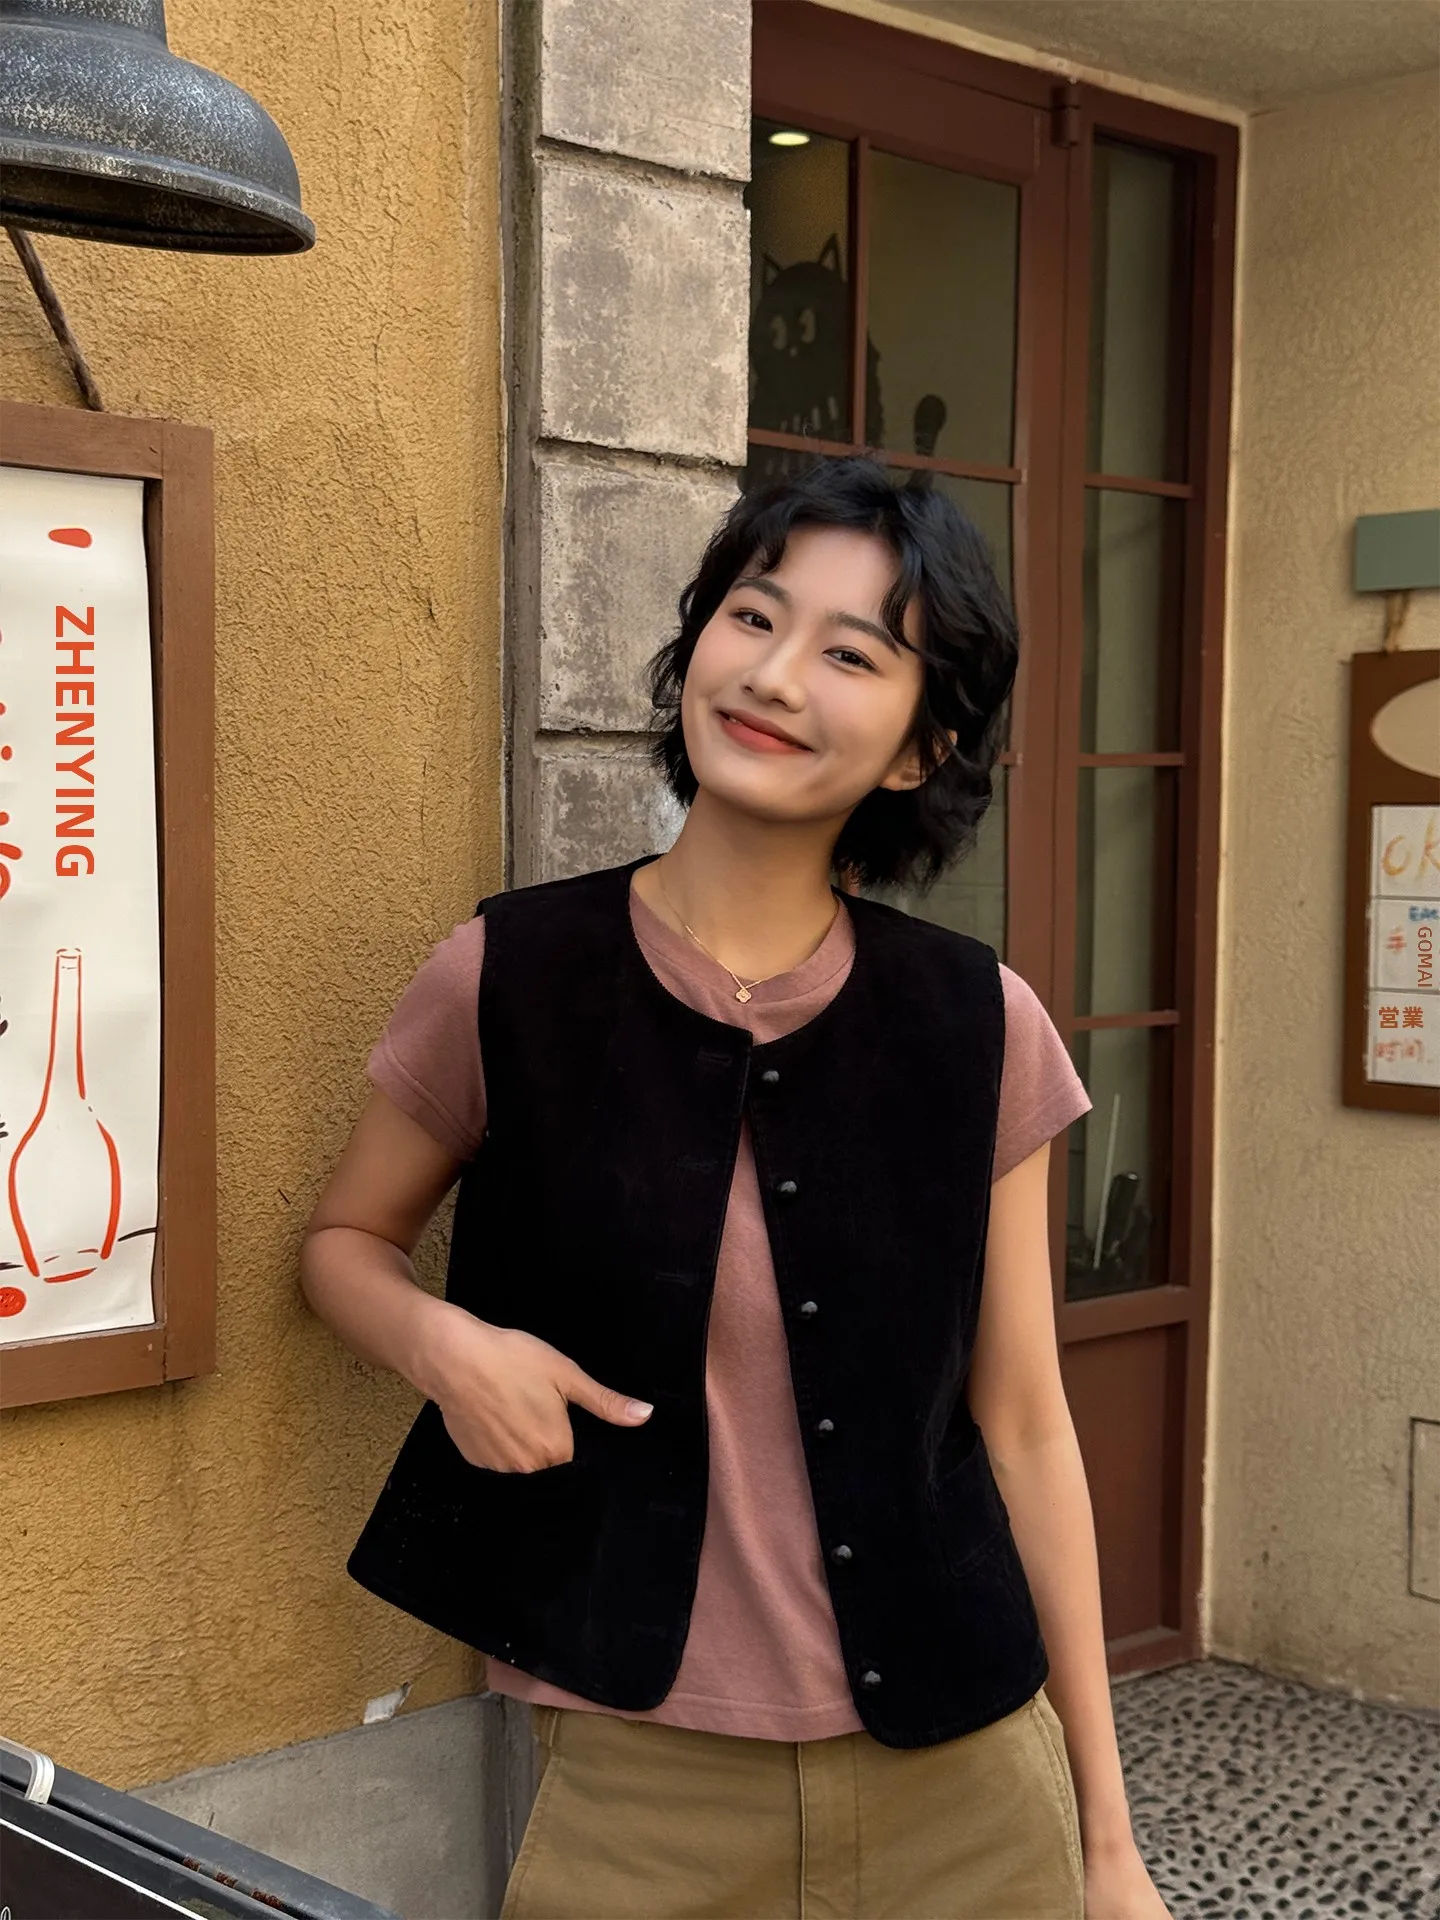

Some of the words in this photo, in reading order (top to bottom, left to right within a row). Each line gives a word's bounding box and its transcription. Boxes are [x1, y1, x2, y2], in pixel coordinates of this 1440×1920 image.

[55, 605, 95, 877] ZHENYING
[1417, 926, 1433, 988] GOMAI
[1378, 1006, 1424, 1029] 営業
